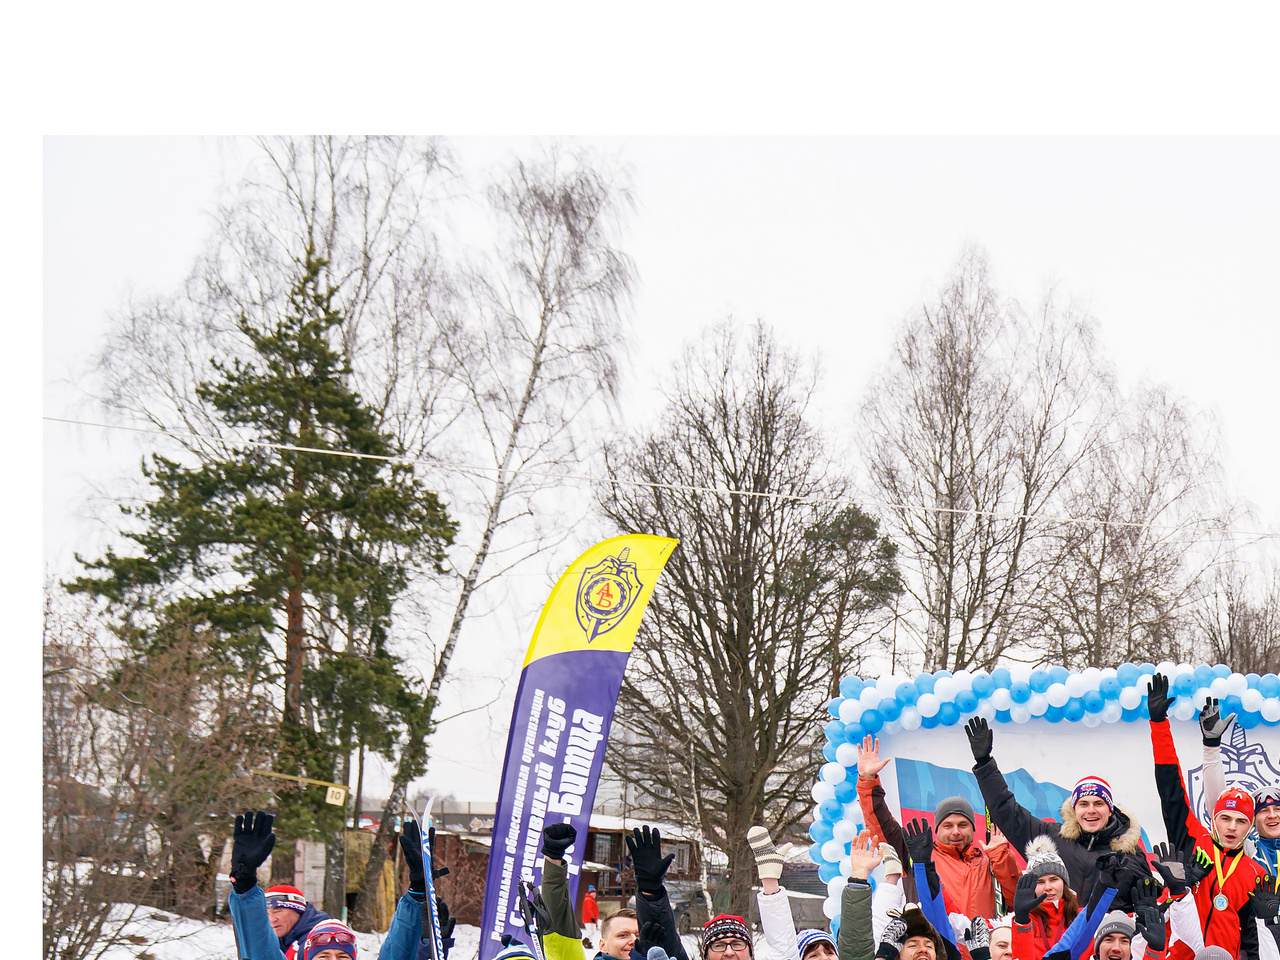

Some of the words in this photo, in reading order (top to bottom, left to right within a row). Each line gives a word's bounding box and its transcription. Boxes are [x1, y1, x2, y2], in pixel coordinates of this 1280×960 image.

[330, 791, 342, 801] 10
[491, 855, 515, 942] Региональная
[505, 764, 530, 854] общественная
[522, 688, 546, 764] организация
